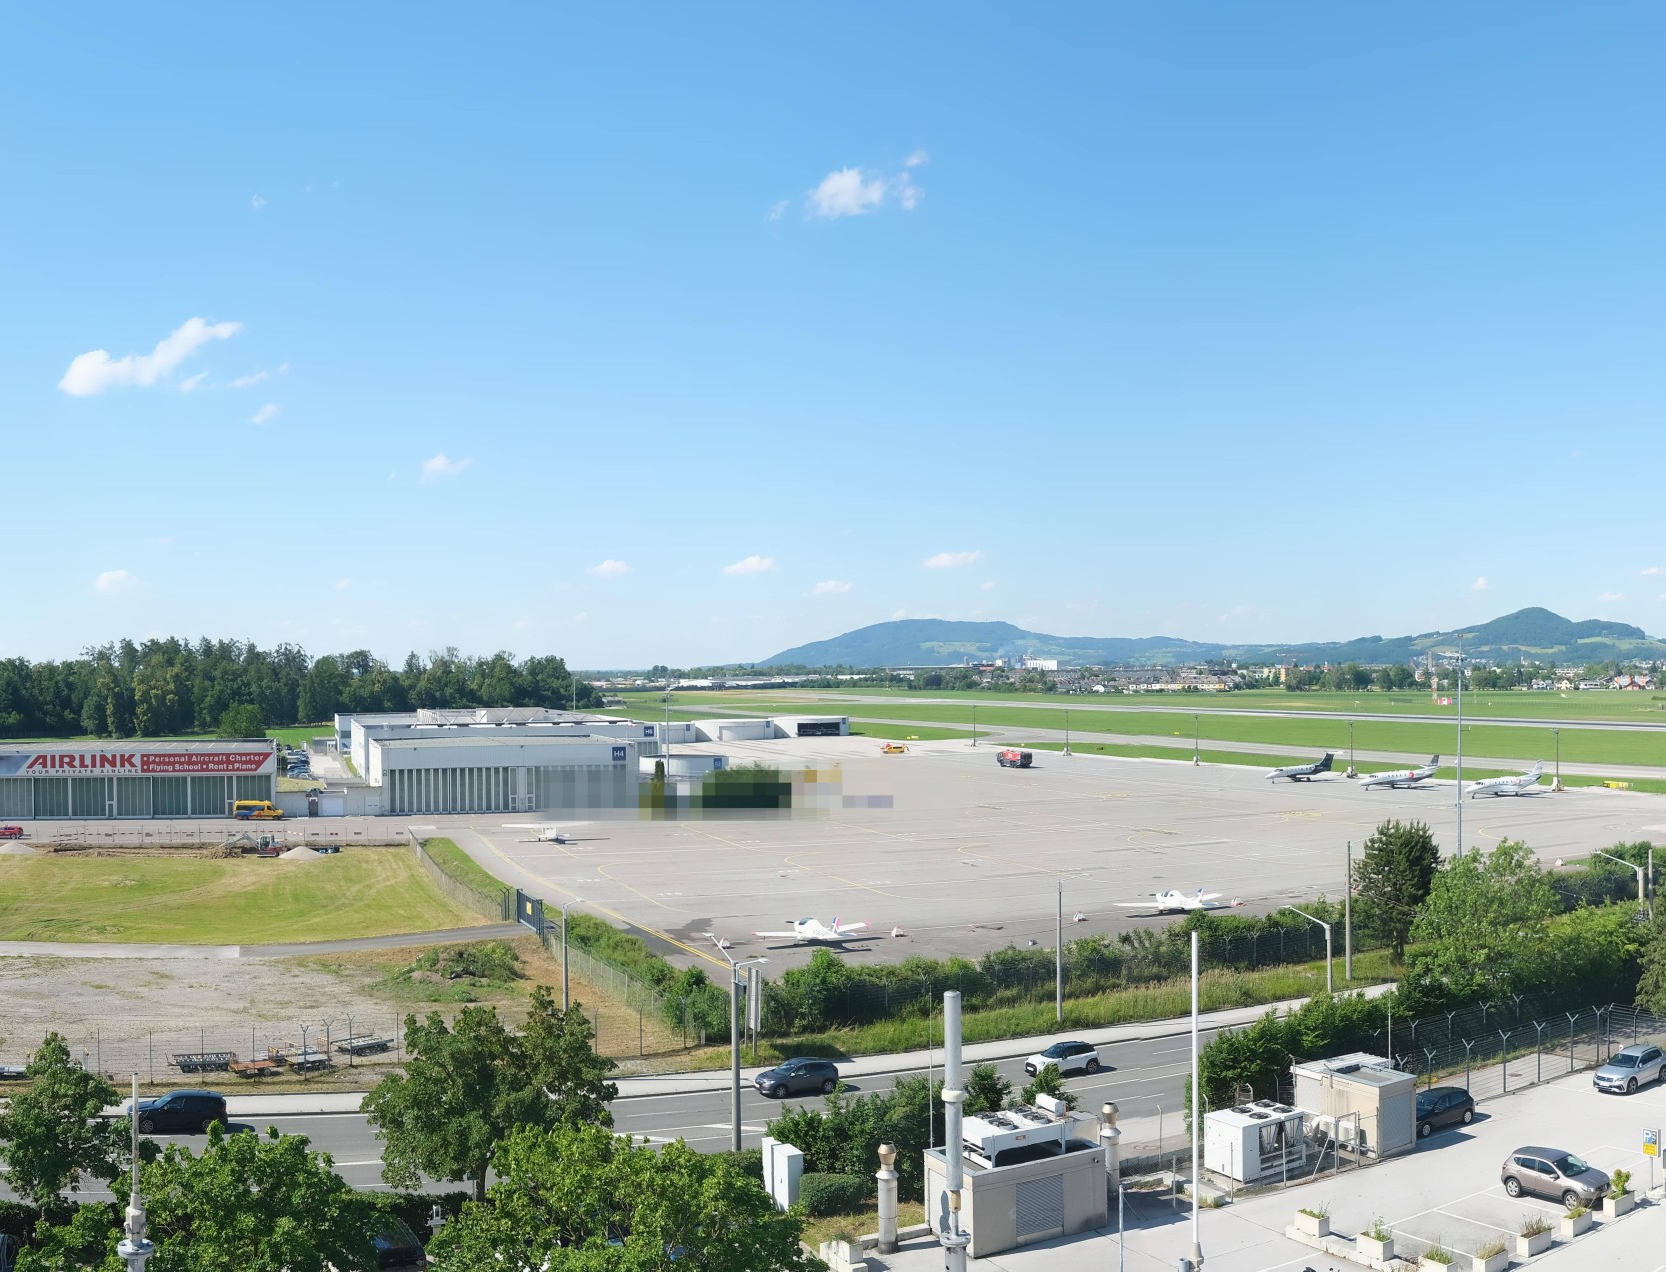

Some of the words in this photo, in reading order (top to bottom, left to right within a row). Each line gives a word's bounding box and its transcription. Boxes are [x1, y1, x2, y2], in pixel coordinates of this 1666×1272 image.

[26, 754, 138, 769] AIRLINK
[191, 754, 226, 762] Aircraft
[149, 763, 173, 771] Flying
[234, 762, 256, 770] Plane
